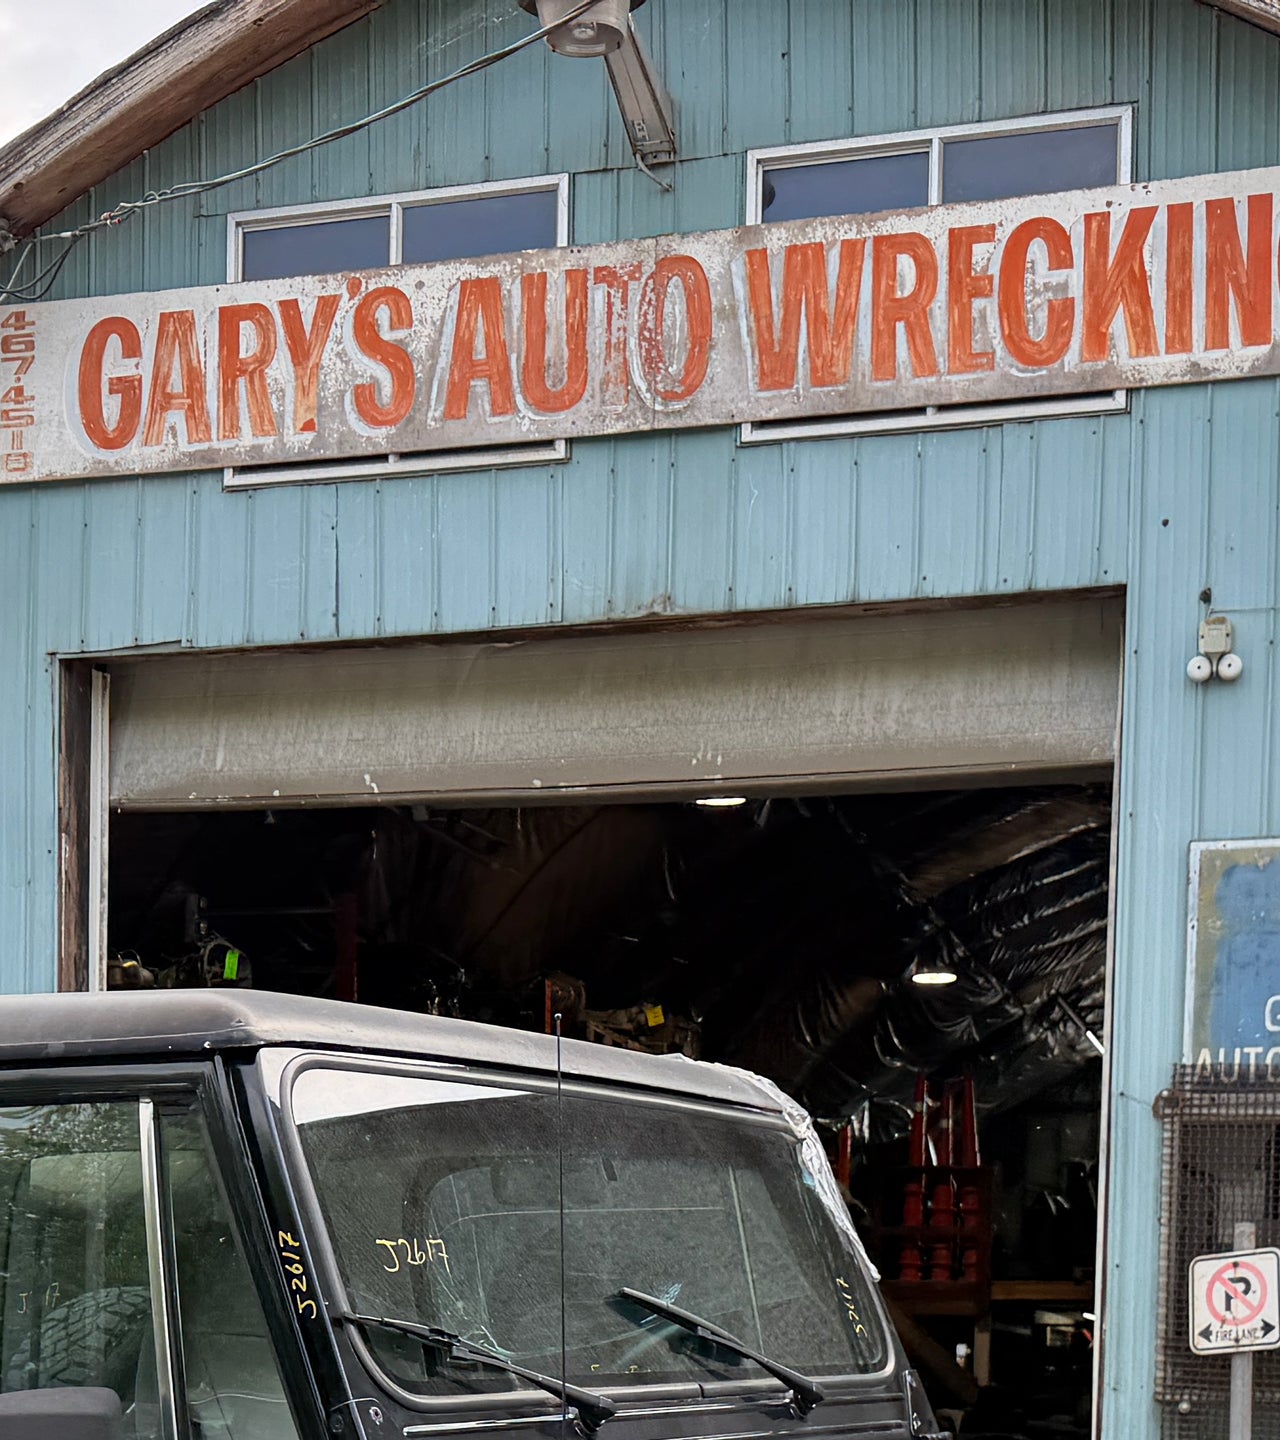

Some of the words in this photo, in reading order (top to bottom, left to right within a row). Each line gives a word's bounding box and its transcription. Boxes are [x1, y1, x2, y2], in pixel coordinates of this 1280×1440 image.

[77, 275, 417, 450] GARY'S
[442, 254, 714, 422] AUTO
[278, 1231, 317, 1320] J2617
[376, 1235, 450, 1273] J2617
